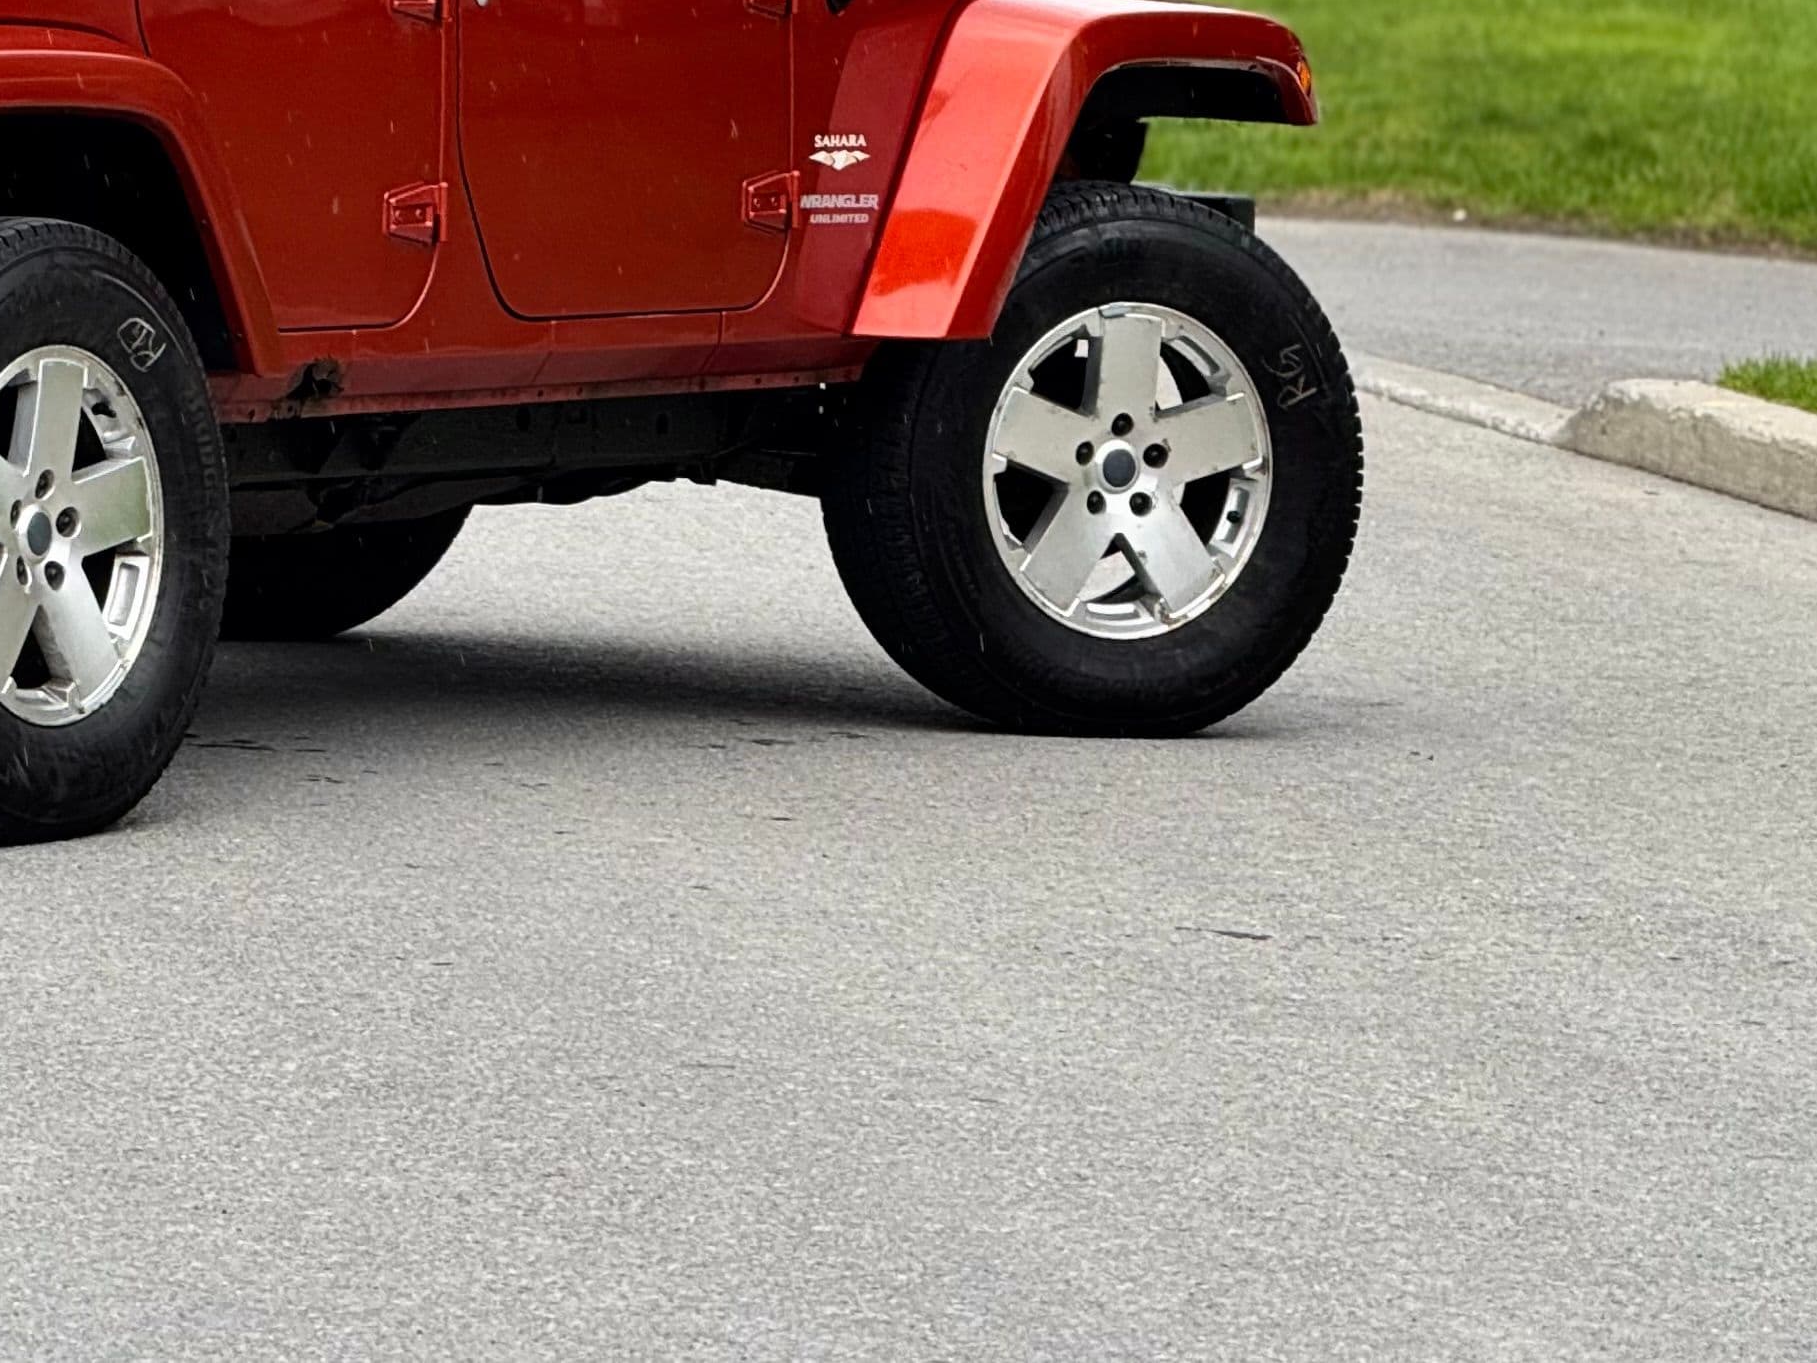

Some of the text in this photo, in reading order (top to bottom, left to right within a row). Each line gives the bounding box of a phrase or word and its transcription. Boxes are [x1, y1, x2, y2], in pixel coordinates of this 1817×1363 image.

[814, 134, 867, 148] SAHARA
[800, 194, 878, 210] WRANGLER
[810, 213, 869, 224] UNLIMITED
